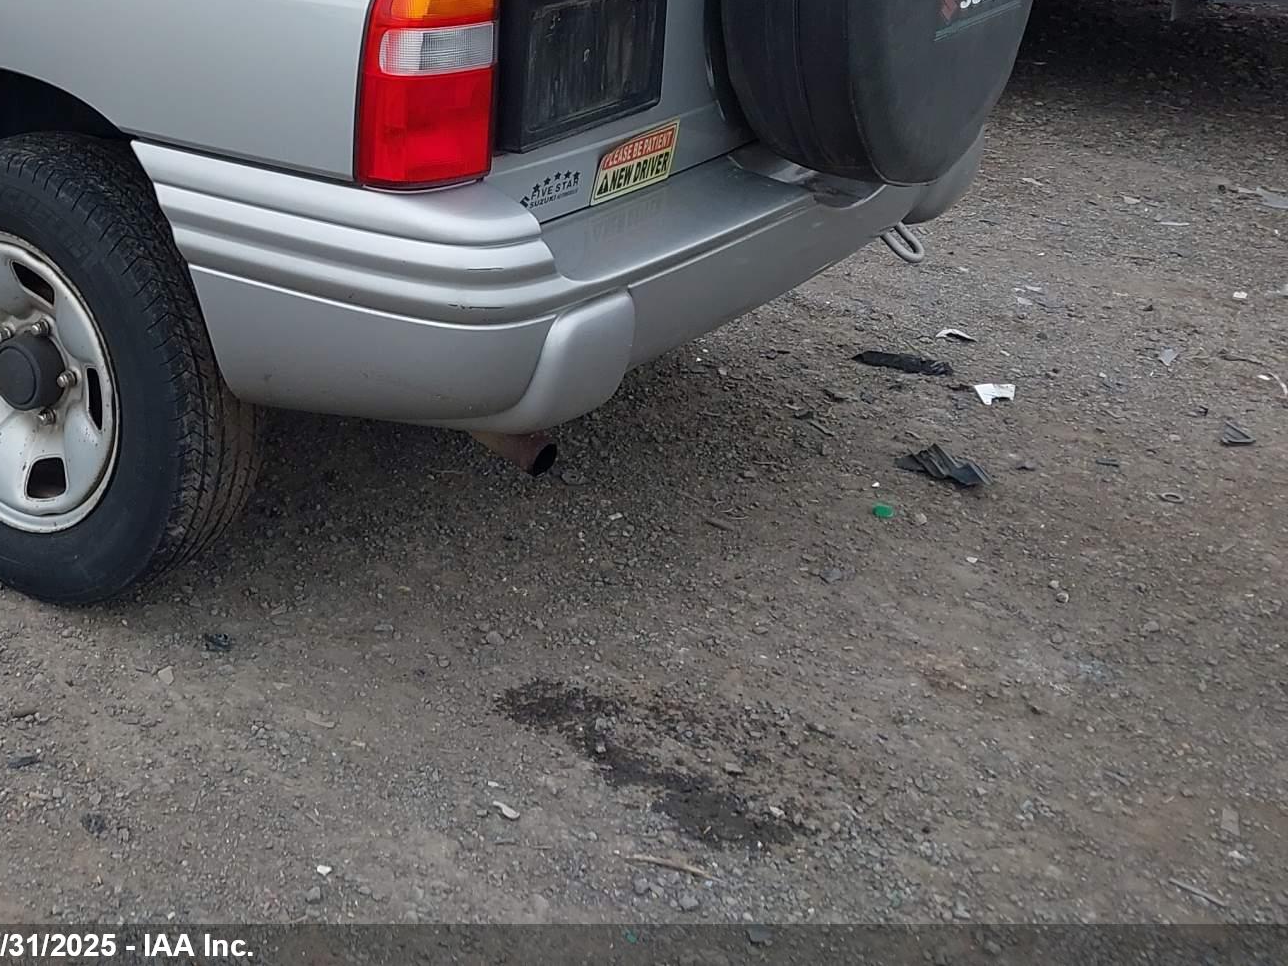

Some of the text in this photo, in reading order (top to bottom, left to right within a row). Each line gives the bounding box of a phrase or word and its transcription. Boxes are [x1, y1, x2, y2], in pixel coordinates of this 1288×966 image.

[604, 131, 673, 167] PLEASE BE PATIENT
[608, 151, 670, 192] NEW DRIVER
[529, 194, 558, 209] SUZUKI
[531, 185, 554, 200] FIVE
[554, 178, 579, 193] STAR
